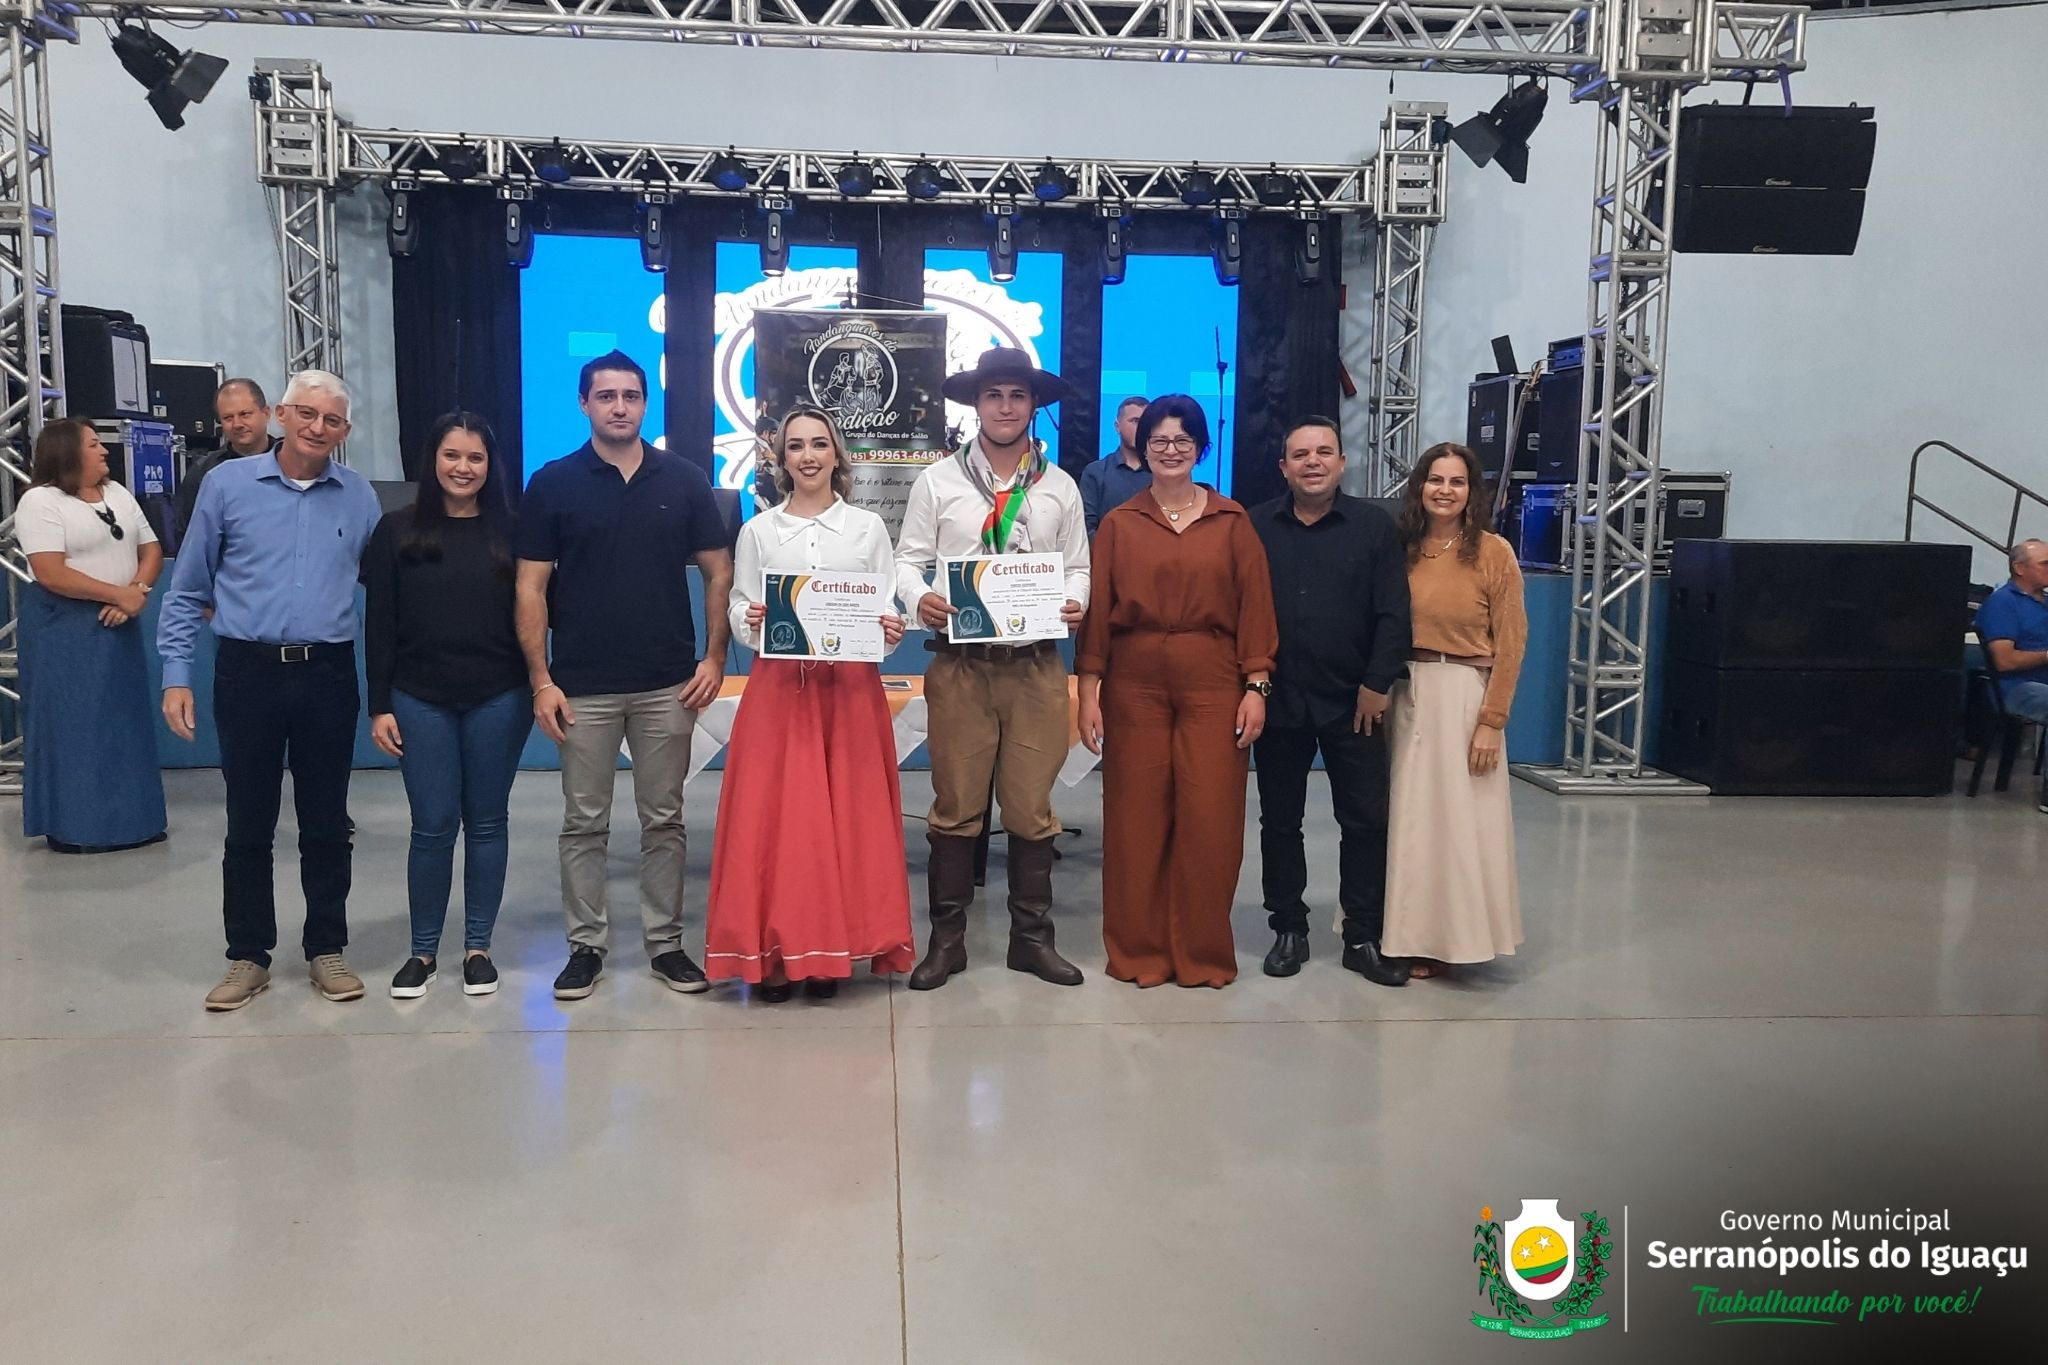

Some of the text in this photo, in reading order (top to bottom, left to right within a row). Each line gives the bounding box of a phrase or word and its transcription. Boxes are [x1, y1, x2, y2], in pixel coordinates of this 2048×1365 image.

[845, 431, 866, 439] Grupo
[869, 450, 944, 461] 99963-6490
[992, 562, 1055, 576] Certificado
[811, 580, 877, 595] Certificado
